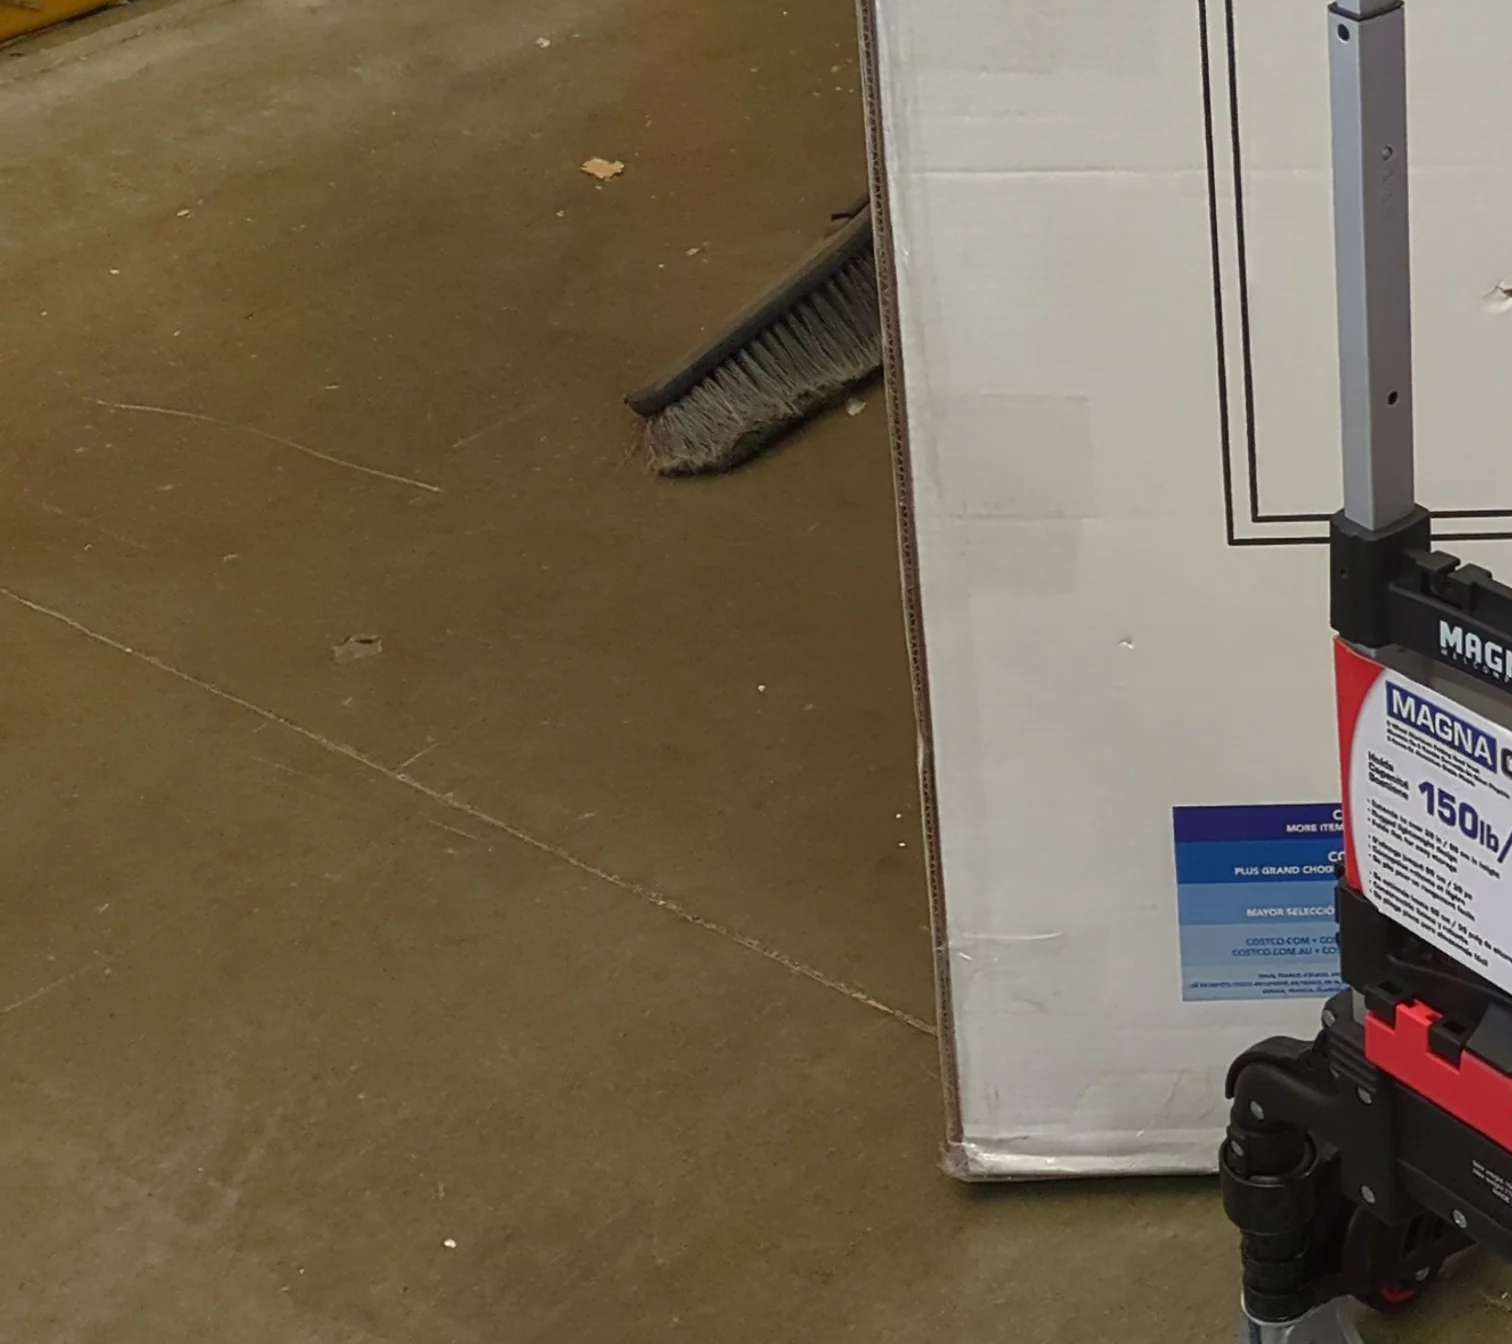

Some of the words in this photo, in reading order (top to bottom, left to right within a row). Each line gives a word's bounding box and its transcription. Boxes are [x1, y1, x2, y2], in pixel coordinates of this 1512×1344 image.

[1392, 689, 1496, 767] MAGNA
[1286, 824, 1317, 833] MORE
[1262, 866, 1300, 875] GRAND
